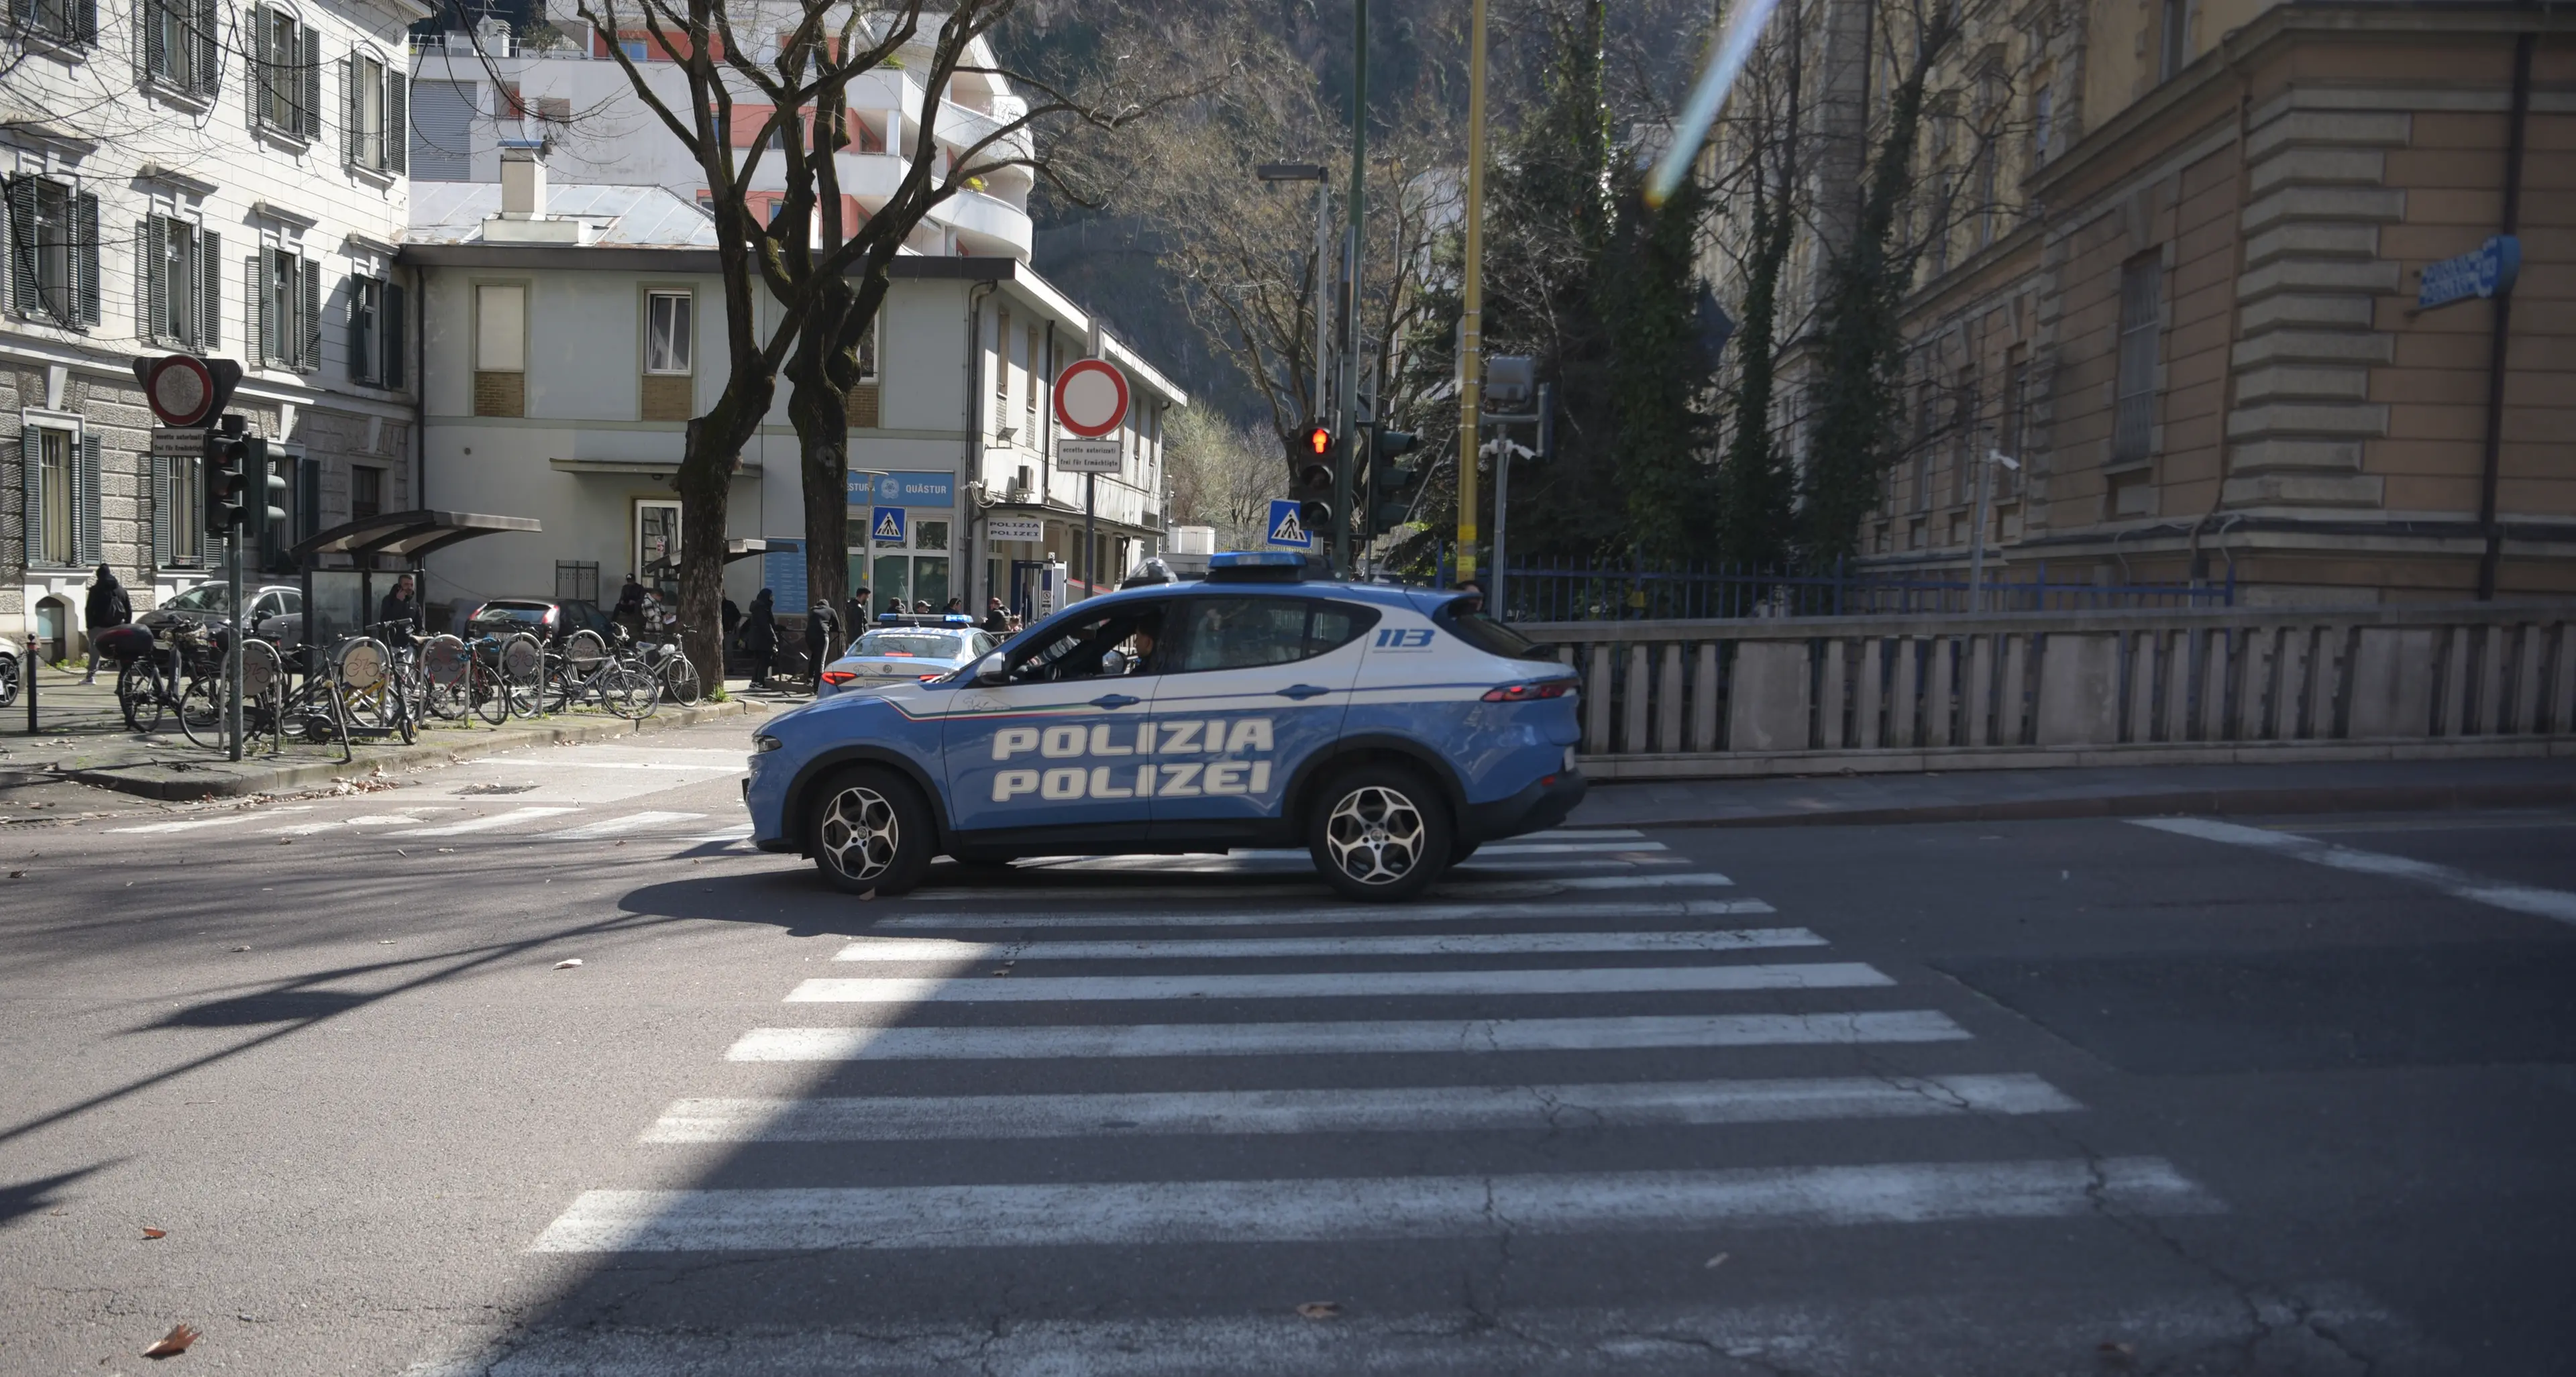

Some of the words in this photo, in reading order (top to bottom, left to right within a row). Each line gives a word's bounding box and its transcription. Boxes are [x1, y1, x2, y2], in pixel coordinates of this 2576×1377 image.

[906, 483, 947, 494] QUÄSTUR
[1375, 628, 1436, 647] 113
[992, 718, 1275, 761] POLIZIA
[992, 761, 1273, 802] POLIZEI
